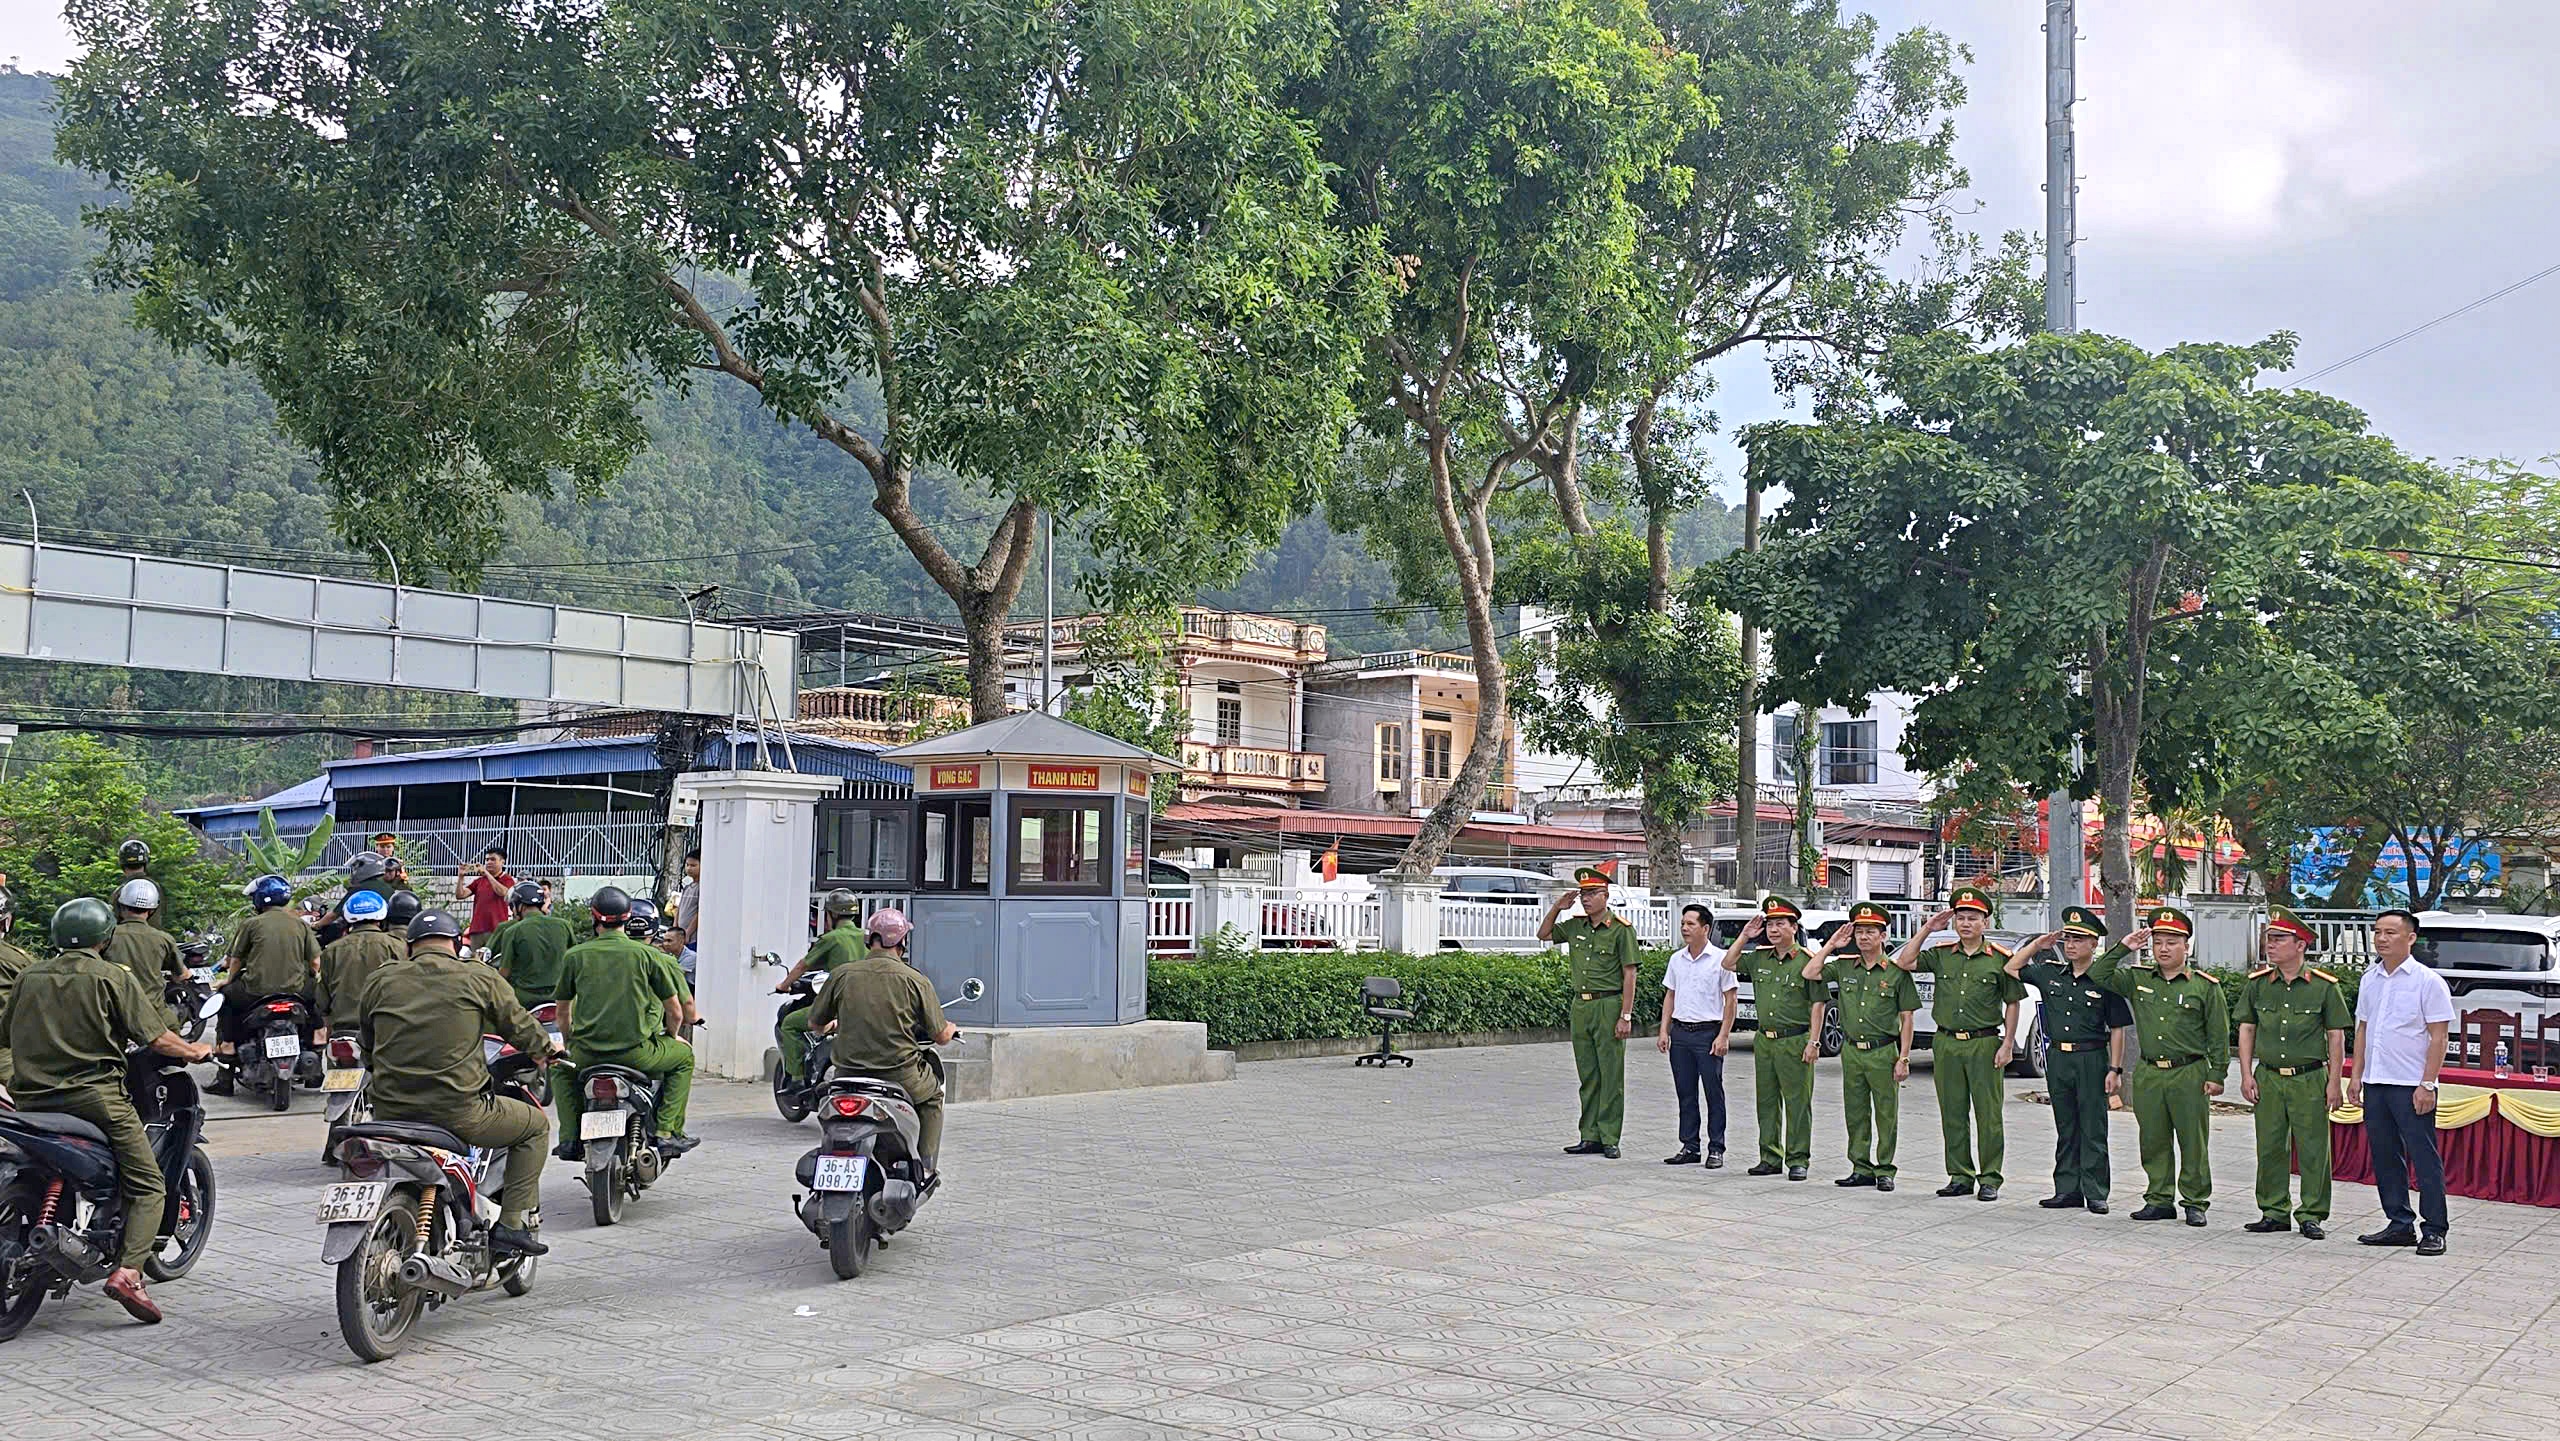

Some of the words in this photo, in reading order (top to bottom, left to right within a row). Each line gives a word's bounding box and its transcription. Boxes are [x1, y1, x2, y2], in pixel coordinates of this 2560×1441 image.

[937, 770, 956, 787] VỌNG
[958, 767, 973, 784] GÁC
[1032, 771, 1067, 786] THANH
[1070, 770, 1096, 787] NIÊN
[818, 1174, 860, 1189] 098.73
[331, 1185, 375, 1203] 36-B1
[321, 1202, 375, 1220] 365.17
